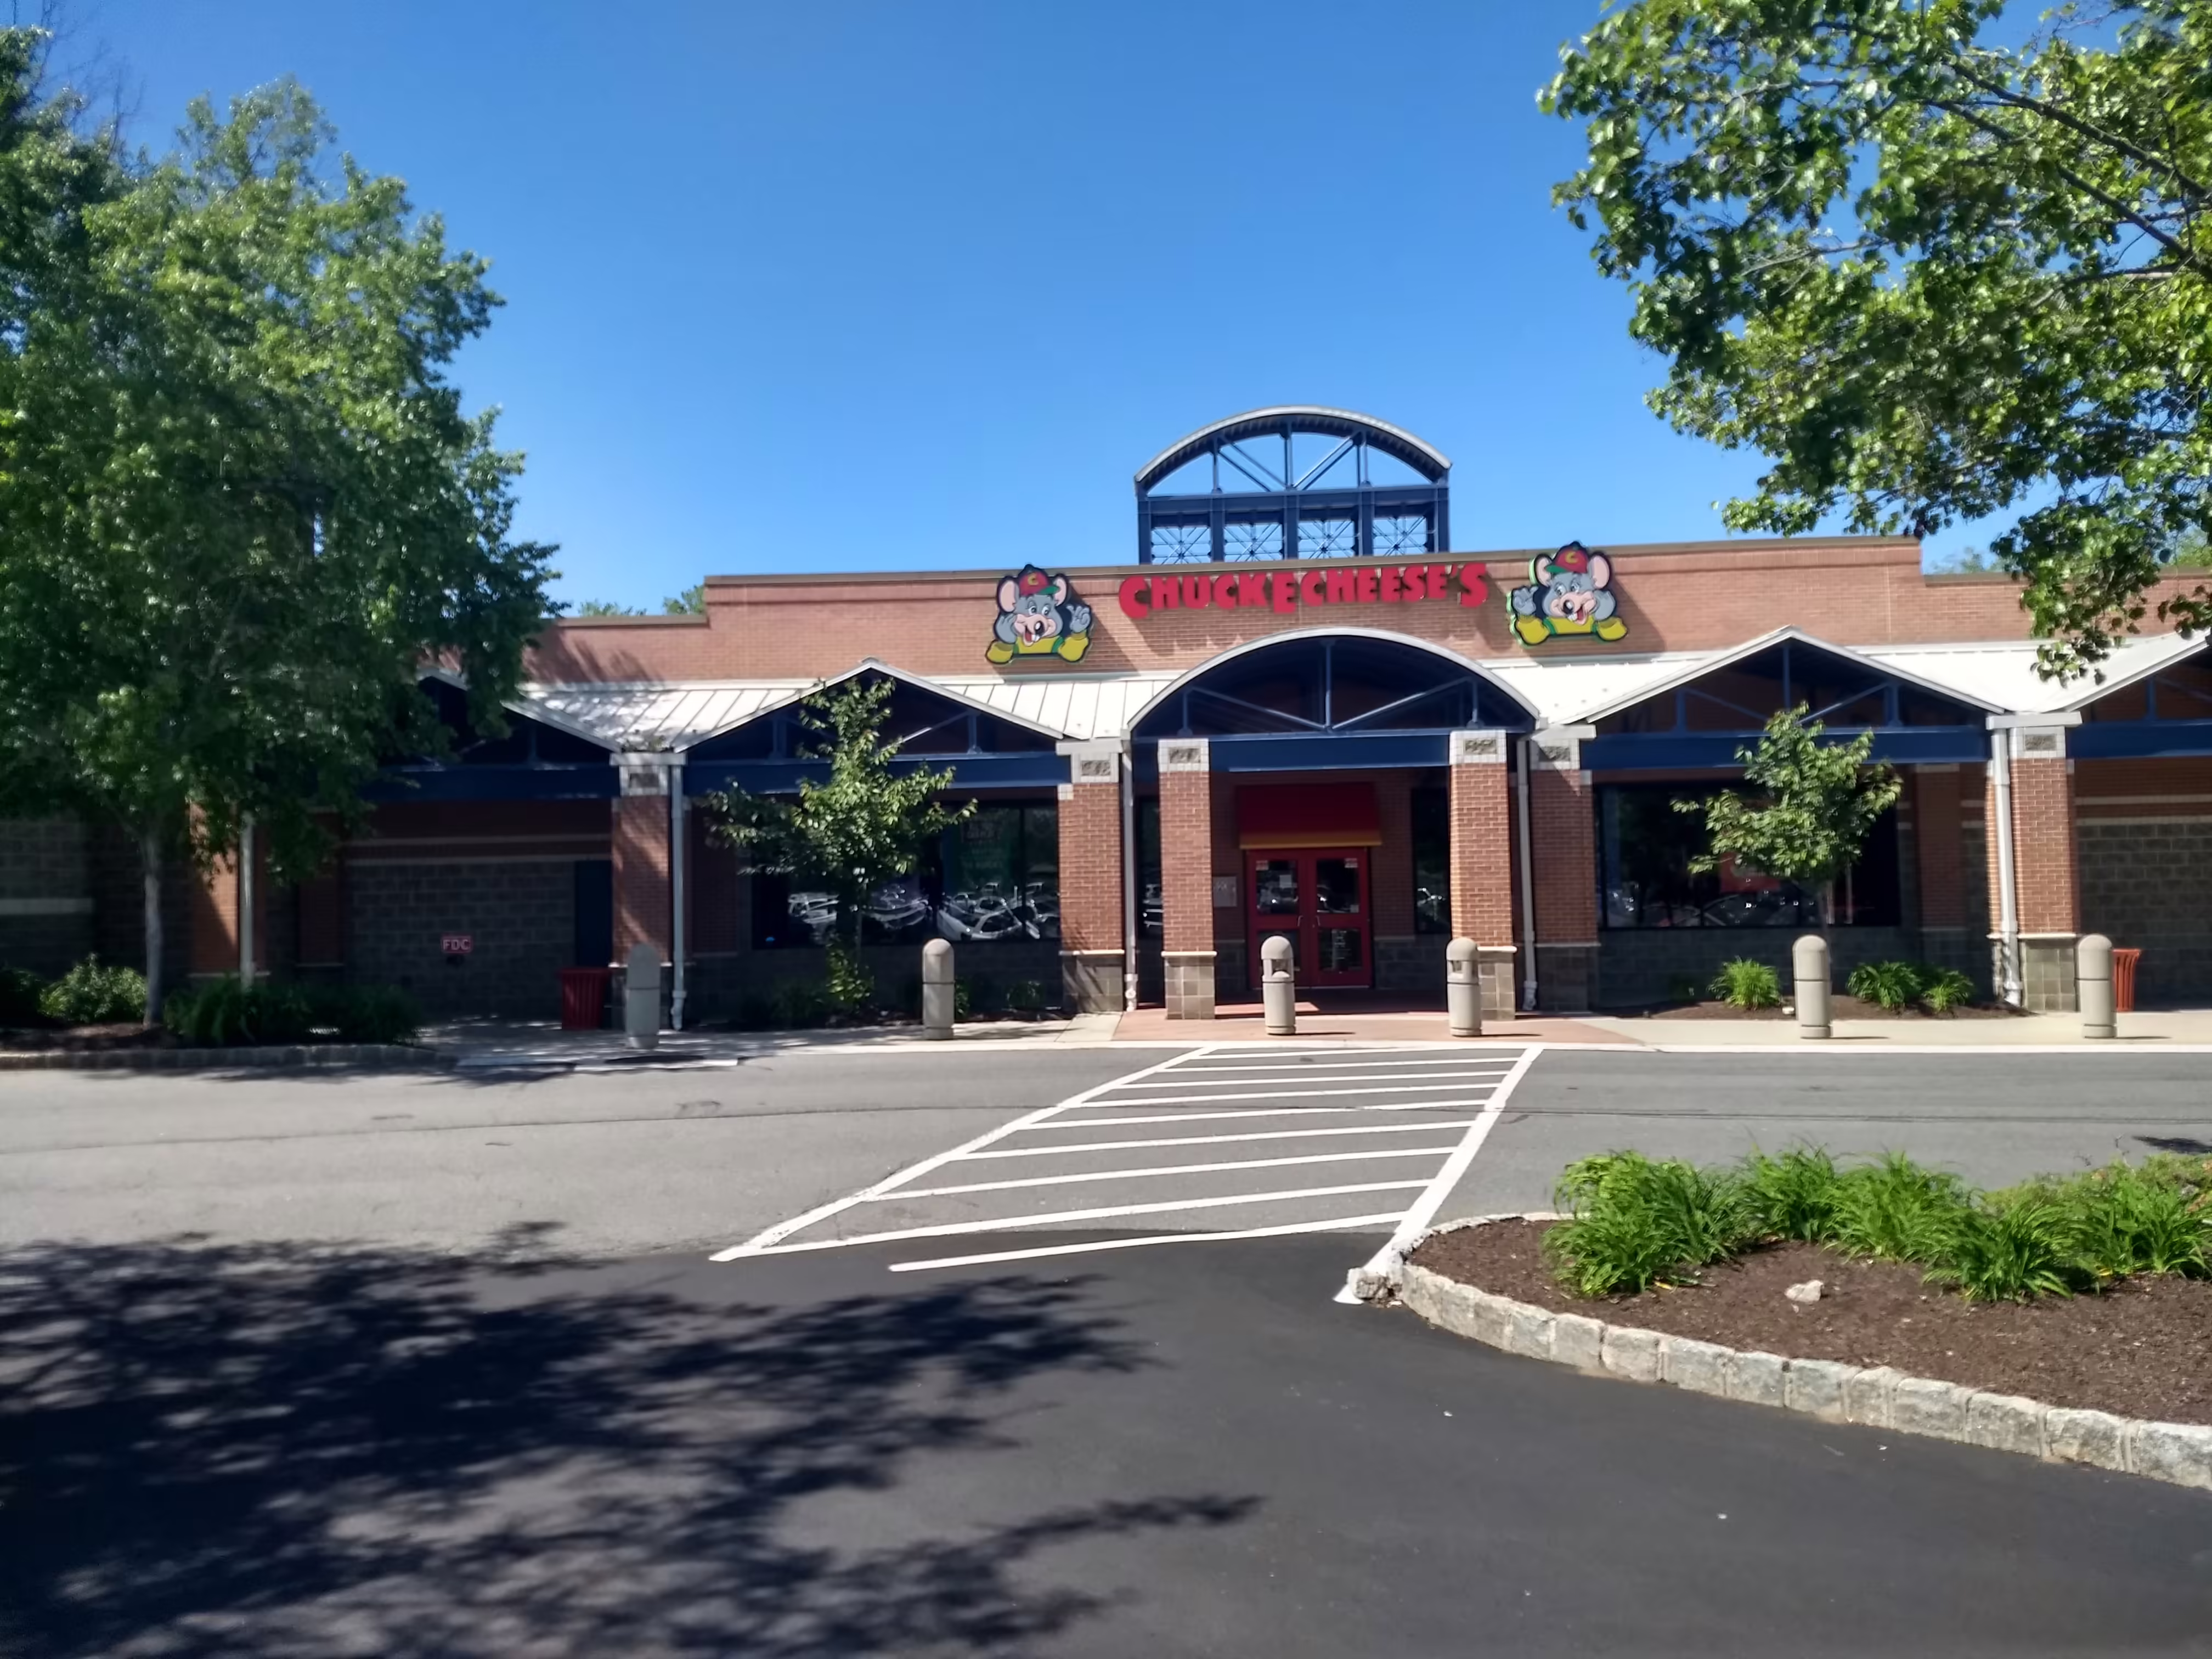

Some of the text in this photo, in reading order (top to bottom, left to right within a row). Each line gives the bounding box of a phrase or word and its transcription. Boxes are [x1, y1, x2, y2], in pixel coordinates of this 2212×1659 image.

[1119, 562, 1488, 619] CHUCK E CHEESE'S
[443, 939, 470, 950] FDC
